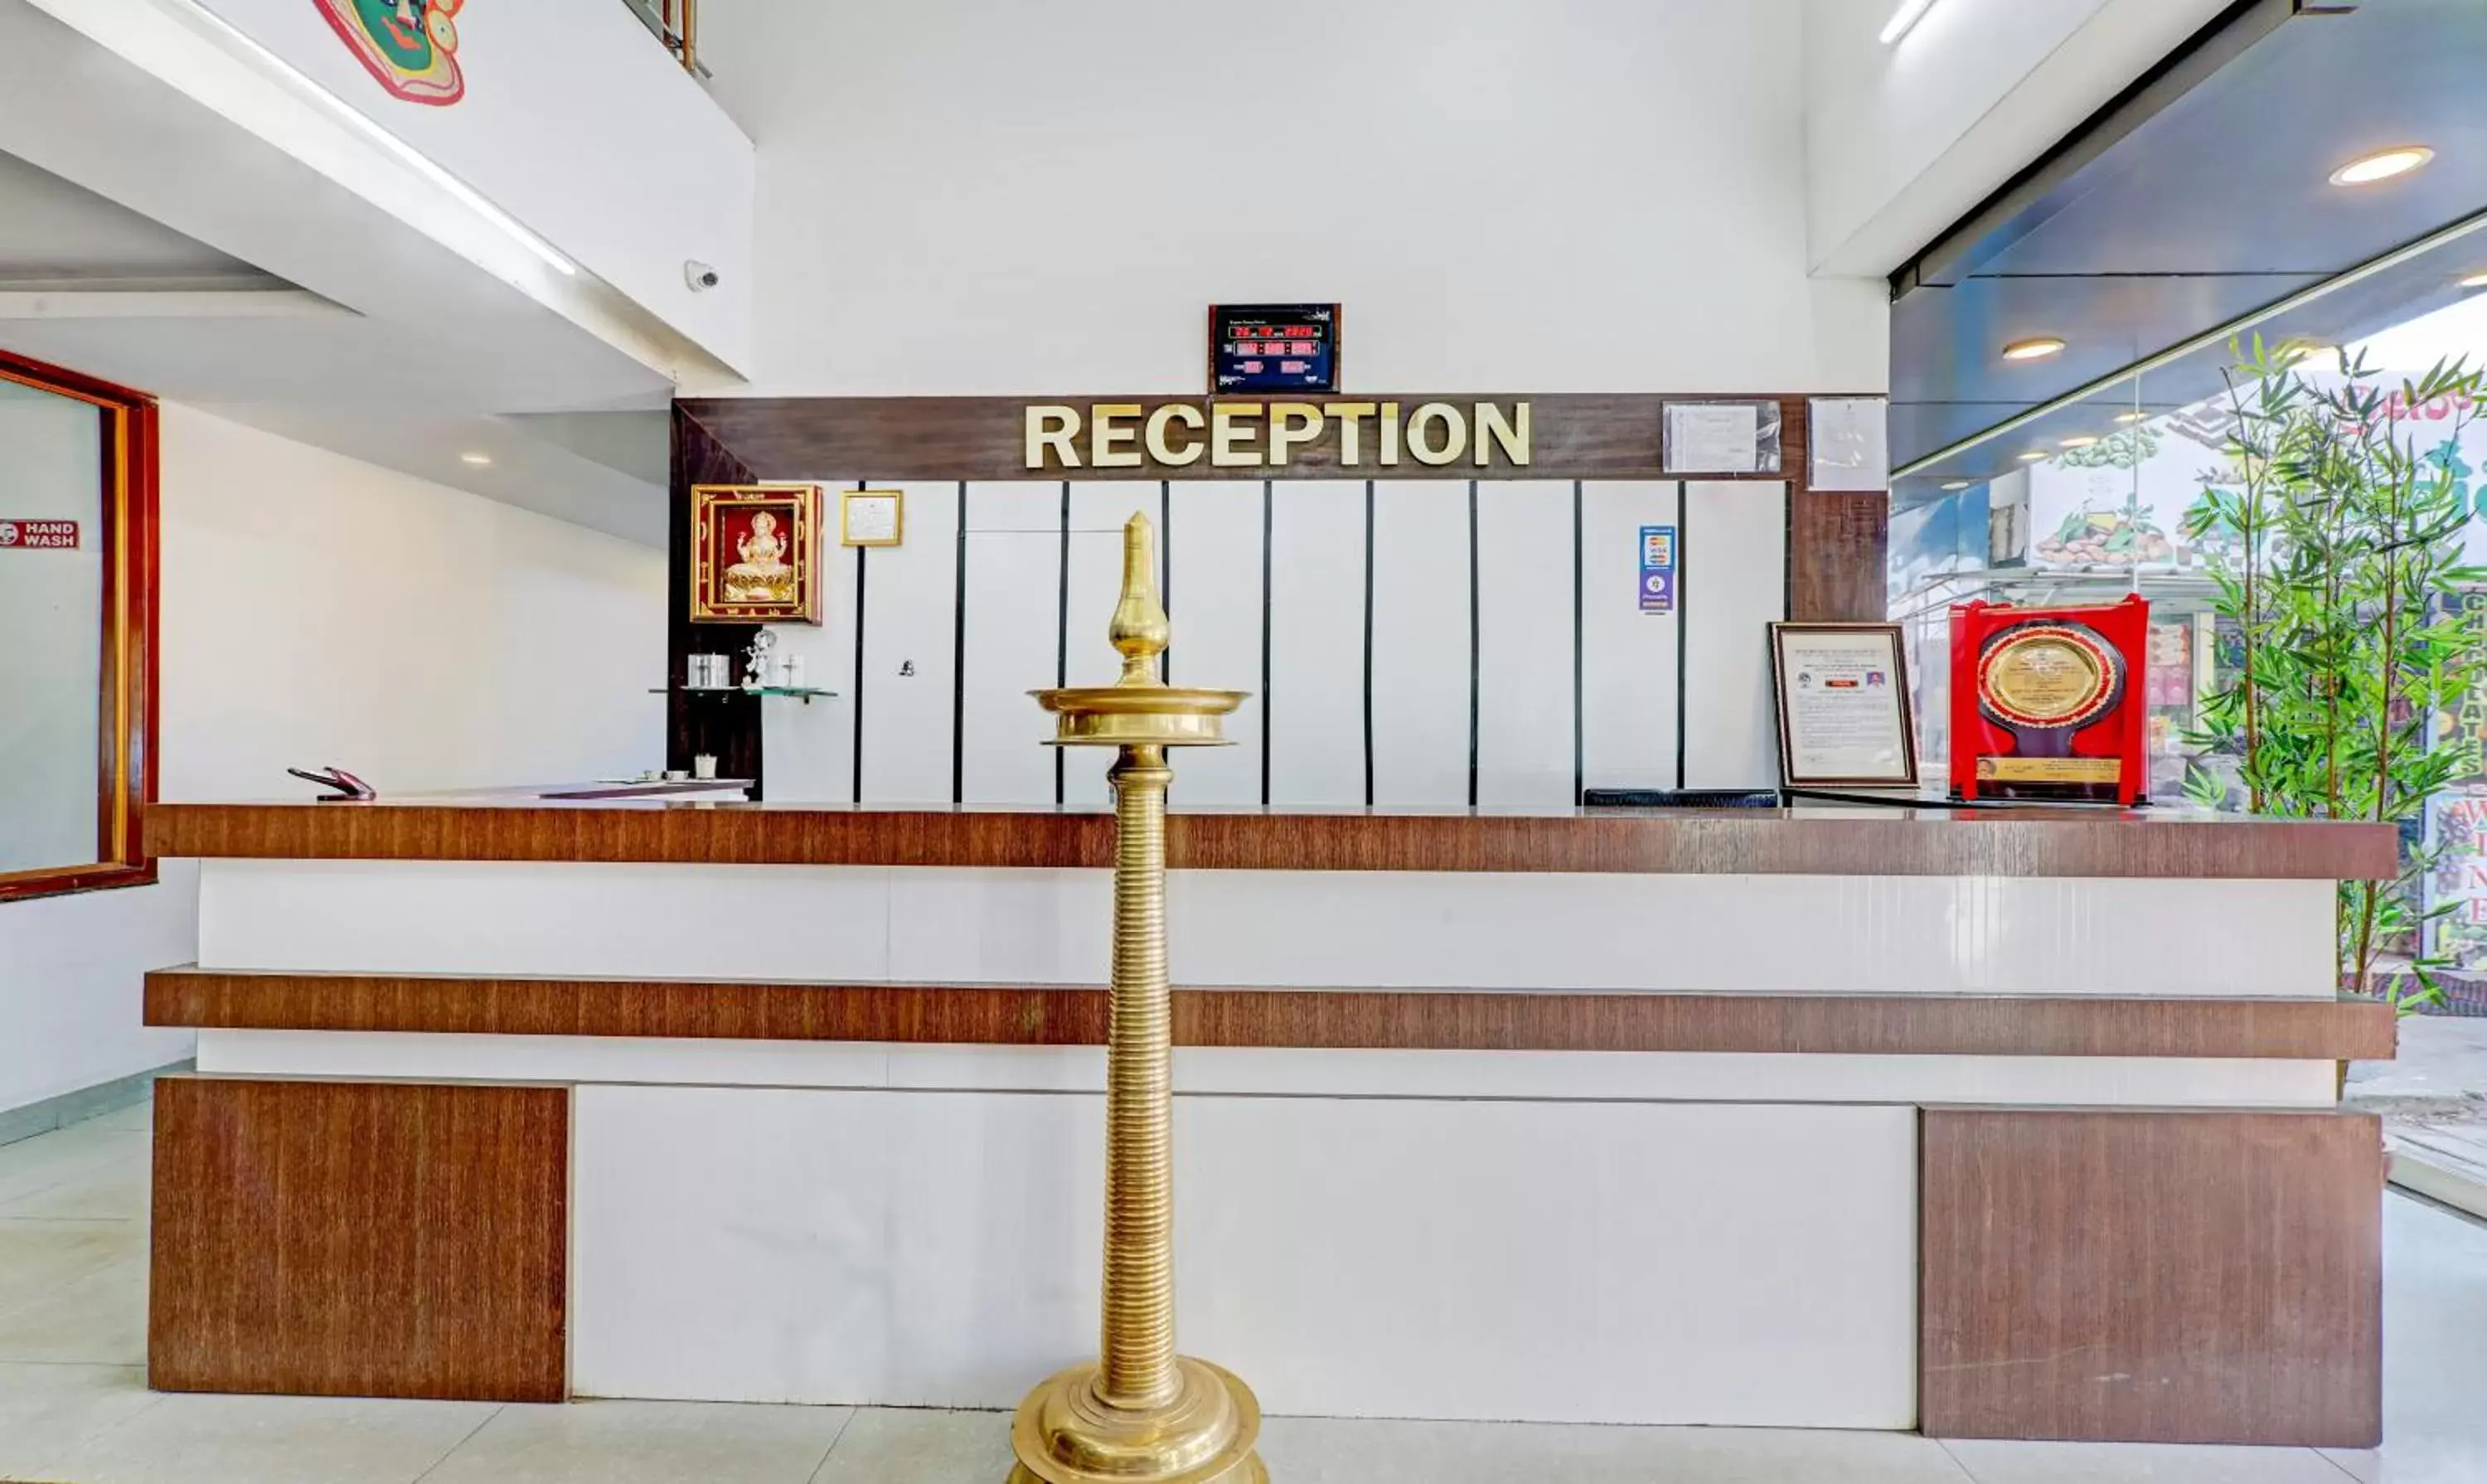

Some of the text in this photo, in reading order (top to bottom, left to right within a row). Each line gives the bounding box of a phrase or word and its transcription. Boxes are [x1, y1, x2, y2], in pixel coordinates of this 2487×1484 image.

[1025, 402, 1530, 468] RECEPTION
[26, 523, 75, 535] HAND
[24, 535, 75, 546] WASH
